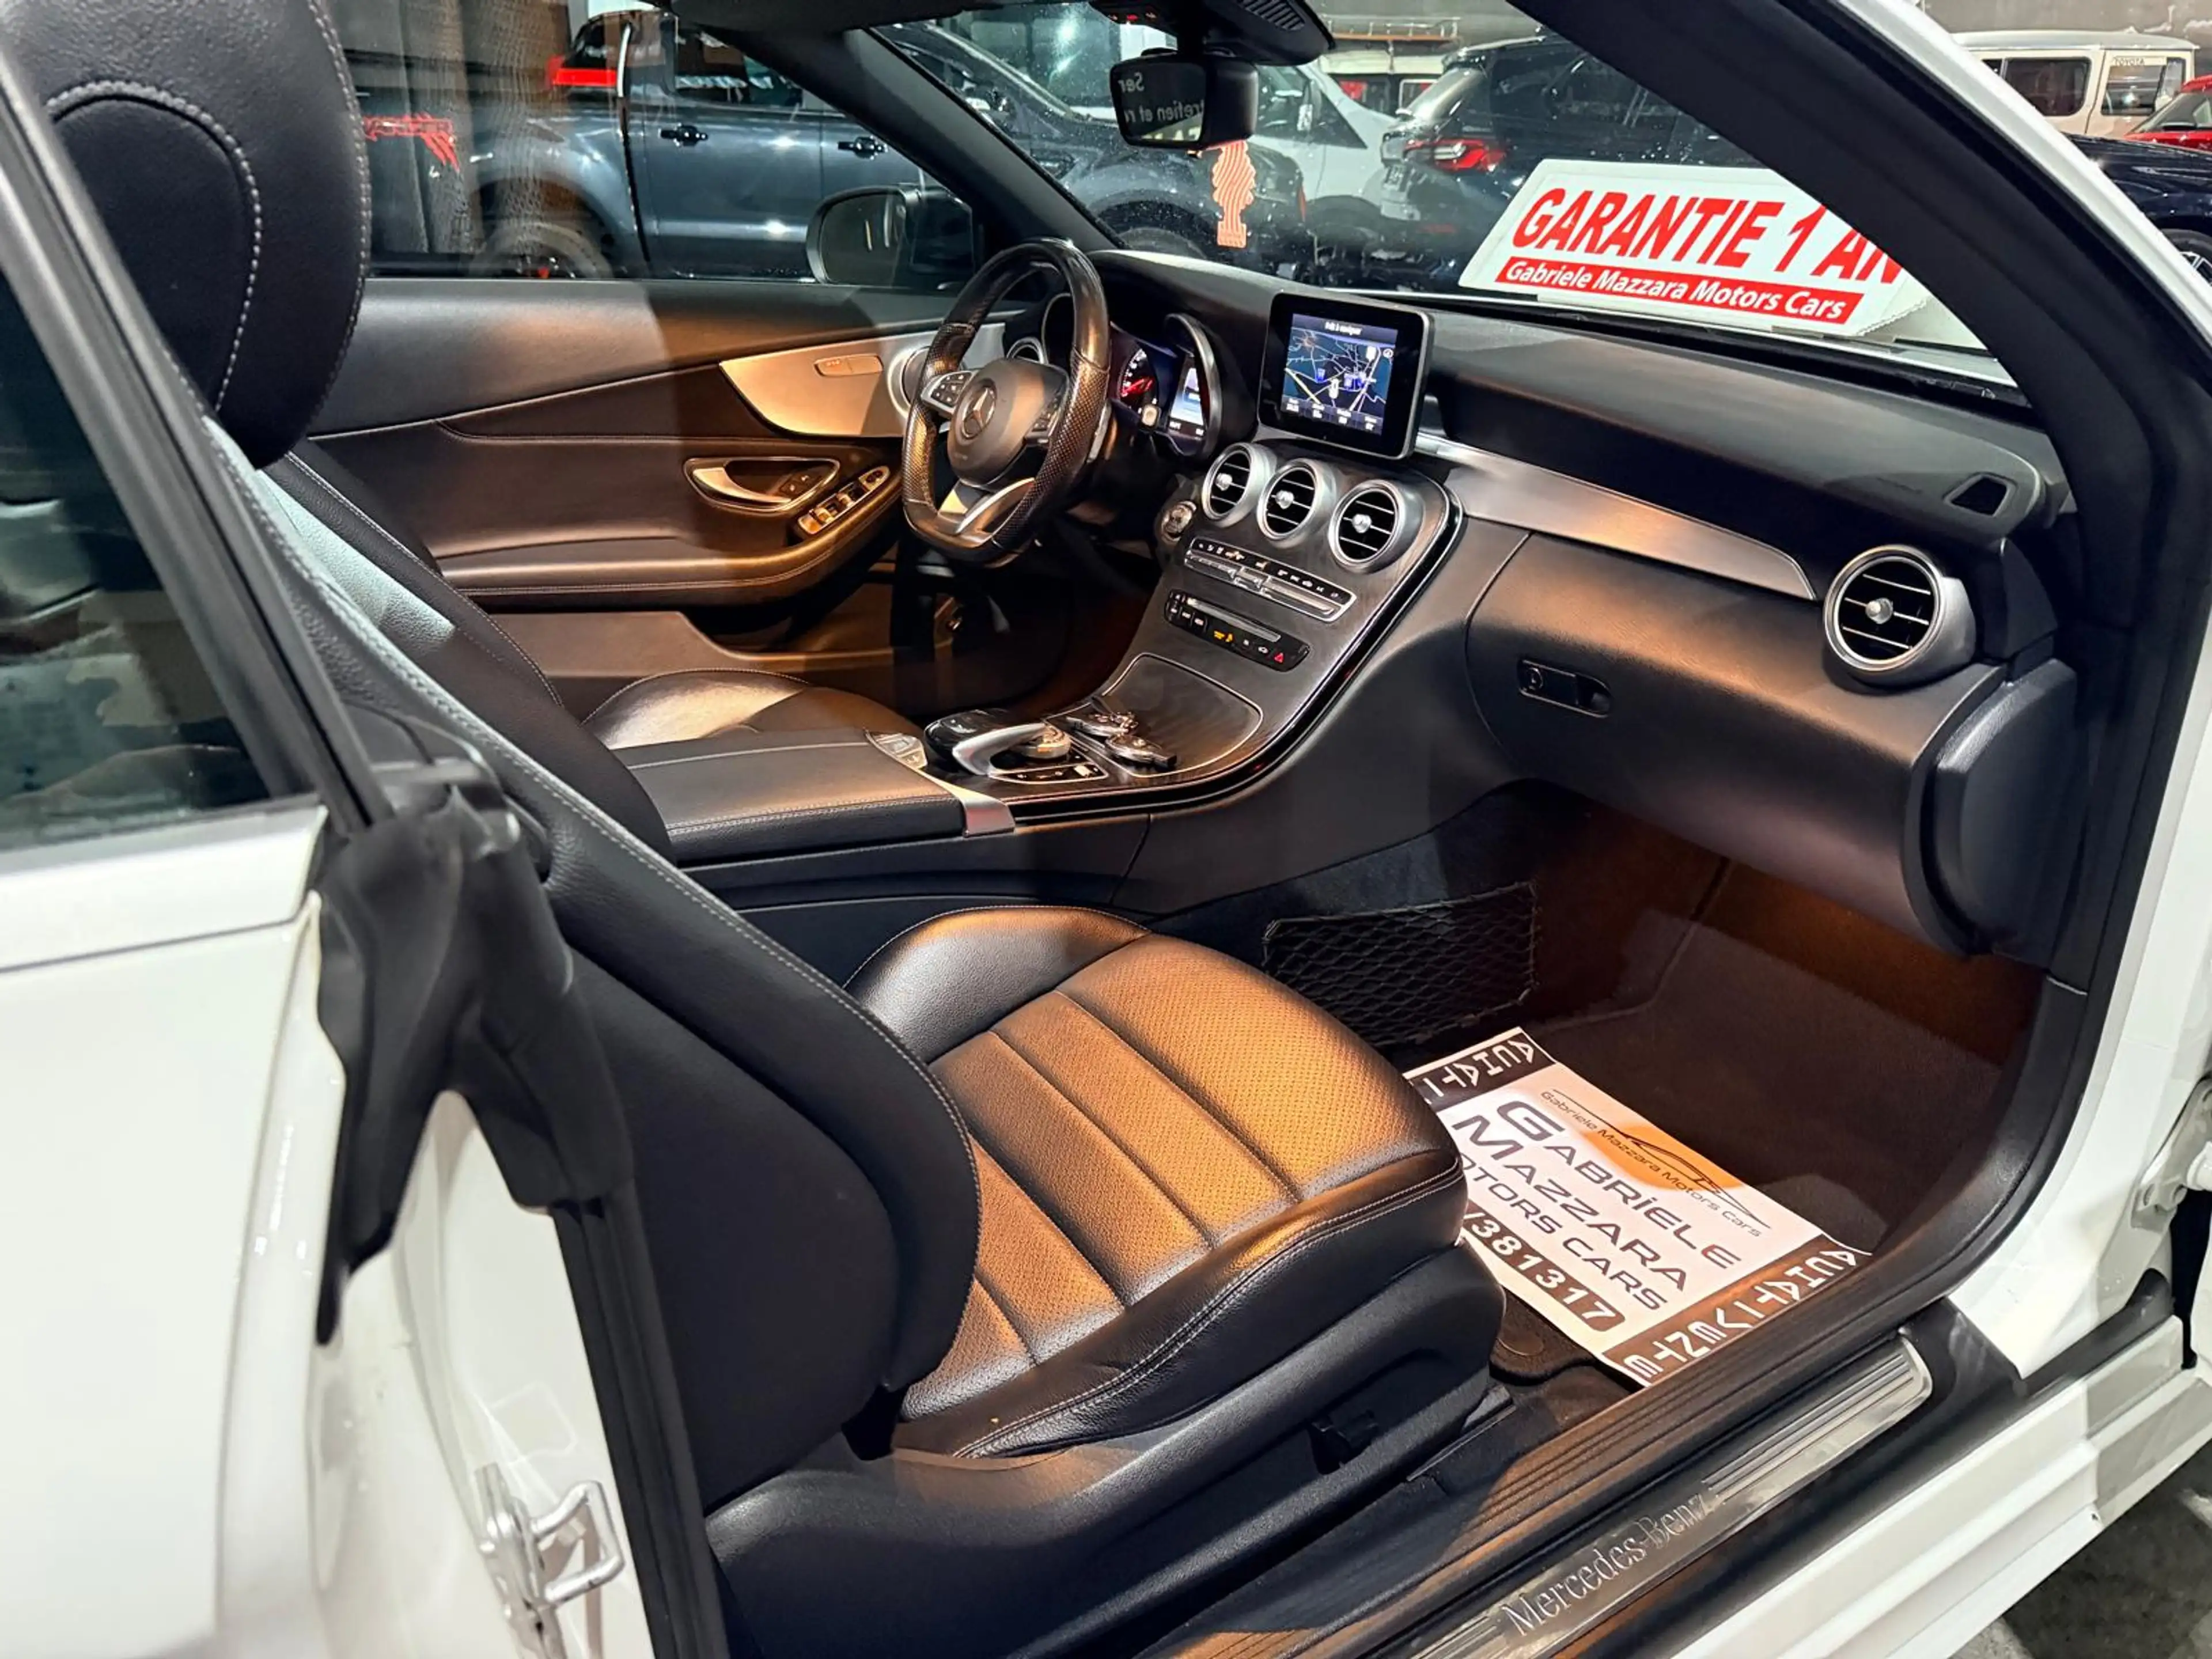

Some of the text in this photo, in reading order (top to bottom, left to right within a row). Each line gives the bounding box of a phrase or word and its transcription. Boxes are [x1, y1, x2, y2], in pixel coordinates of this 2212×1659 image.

[1512, 188, 1785, 268] GARANTIE
[1774, 204, 1827, 272] 1
[1506, 260, 1847, 319] Gabriele Mazzara Motors Cars
[1452, 1115, 1687, 1291] MAZZARA
[1540, 1091, 1762, 1237] Gabriele Mazzara Motors Cars
[1563, 1237, 1668, 1310] CARS
[1502, 1493, 1710, 1637] Mercedes-Benz
